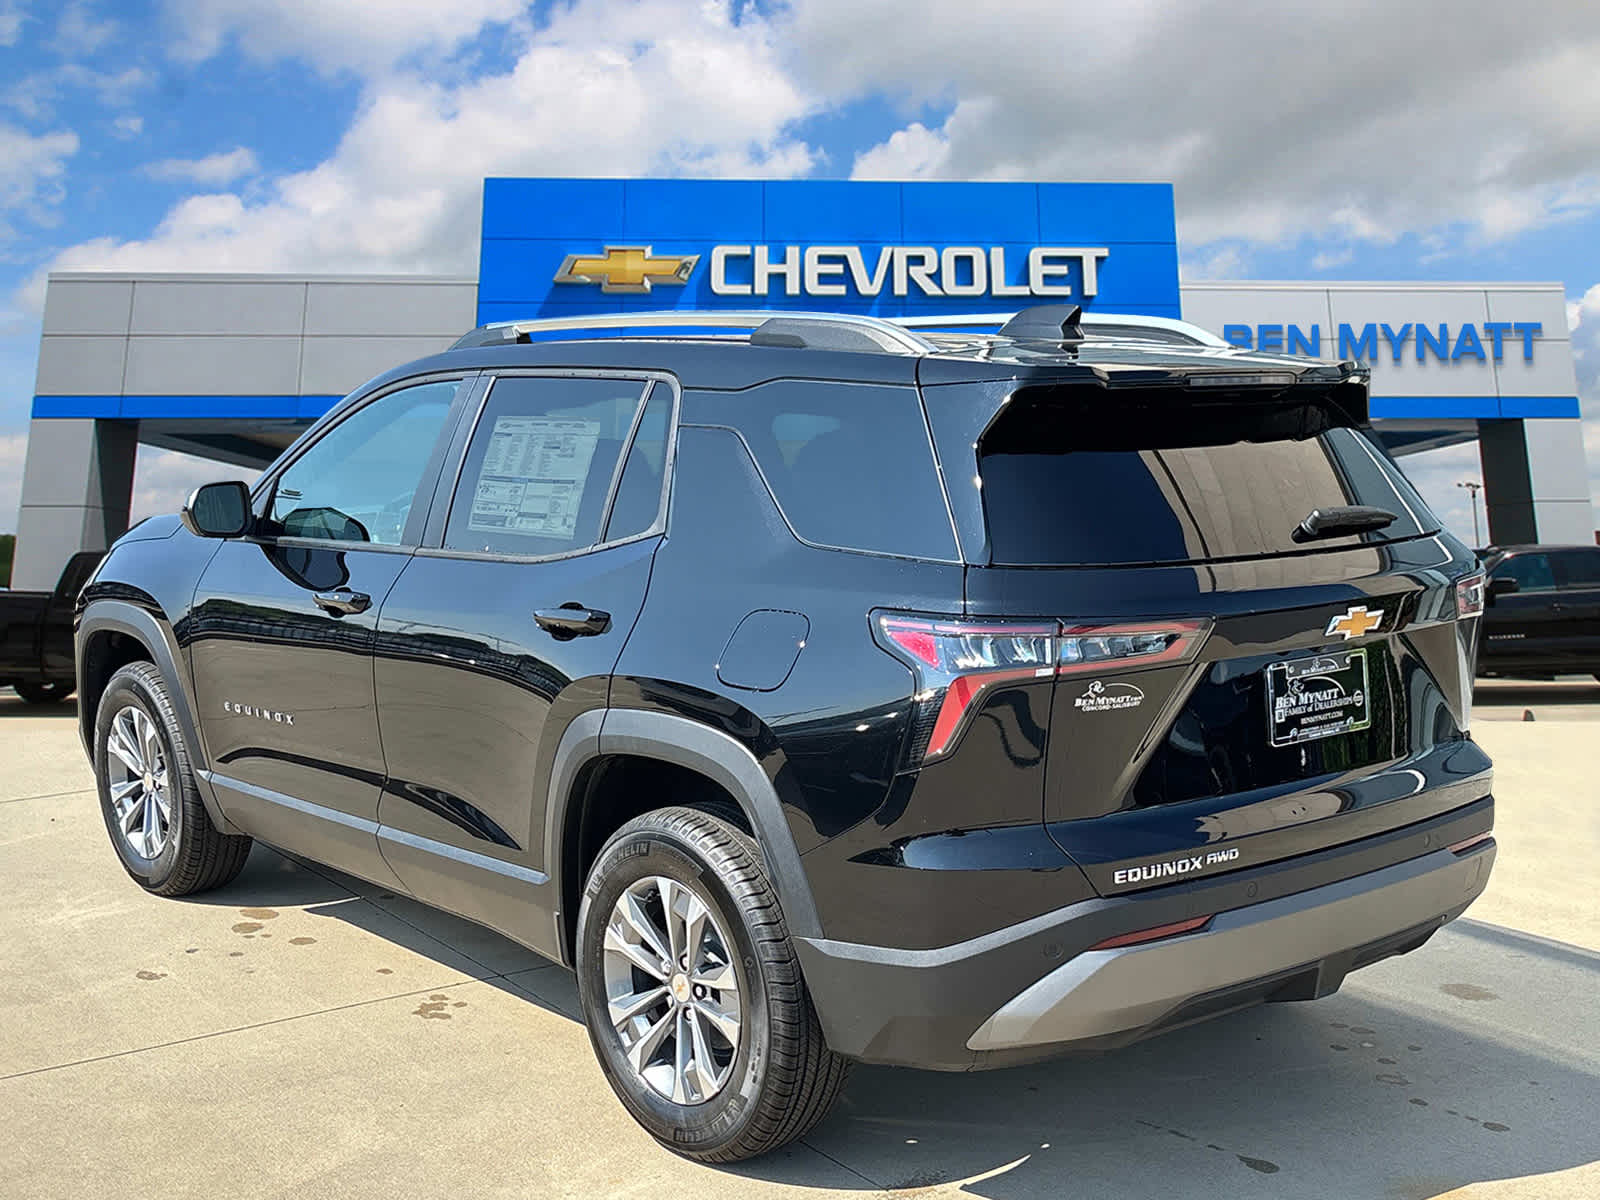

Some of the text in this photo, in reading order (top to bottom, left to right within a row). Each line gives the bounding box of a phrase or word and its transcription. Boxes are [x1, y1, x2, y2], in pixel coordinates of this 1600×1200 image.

[711, 245, 1109, 296] CHEVROLET
[1338, 322, 1542, 362] MYNATT
[224, 701, 295, 726] EQUINOX
[1074, 698, 1095, 707] BEN
[1275, 688, 1339, 710] BEN MYNATT
[1114, 848, 1240, 884] EQUINOX AWD
